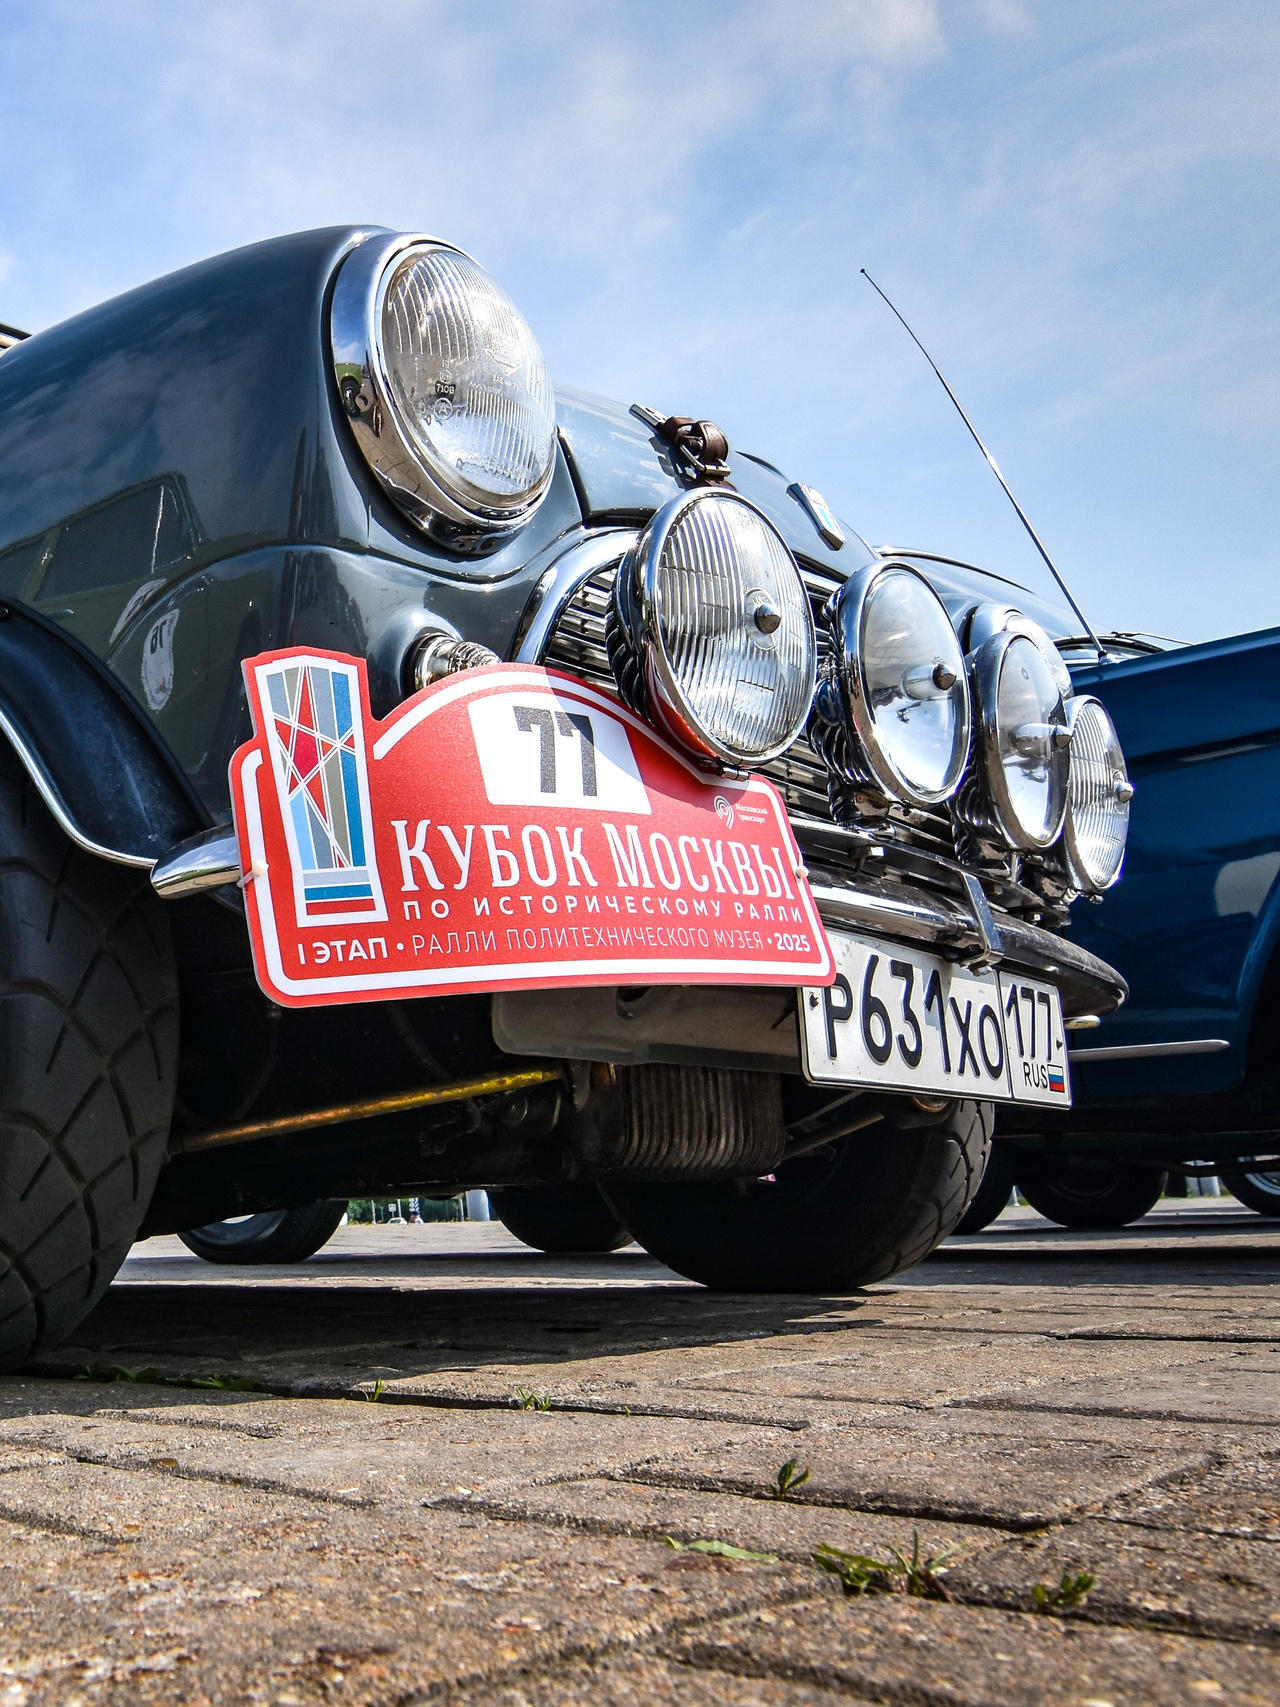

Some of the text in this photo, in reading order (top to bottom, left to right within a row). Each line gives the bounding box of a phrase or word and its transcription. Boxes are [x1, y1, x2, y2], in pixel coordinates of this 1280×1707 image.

[513, 705, 598, 797] 77
[390, 819, 795, 900] КУБОК МОСКВЫ
[403, 895, 803, 923] ПО ИСТОРИЧЕСКОМУ РАЛЛИ
[313, 937, 389, 965] ЭТАП
[412, 930, 497, 956] РАЛЛИ
[506, 926, 709, 951] ПОЛИТЕХНИЧЕСКОГО
[714, 929, 763, 950] МУЗЕЯ
[774, 932, 811, 952] 2025
[1005, 982, 1053, 1062] 177
[1022, 1061, 1049, 1089] RUS
